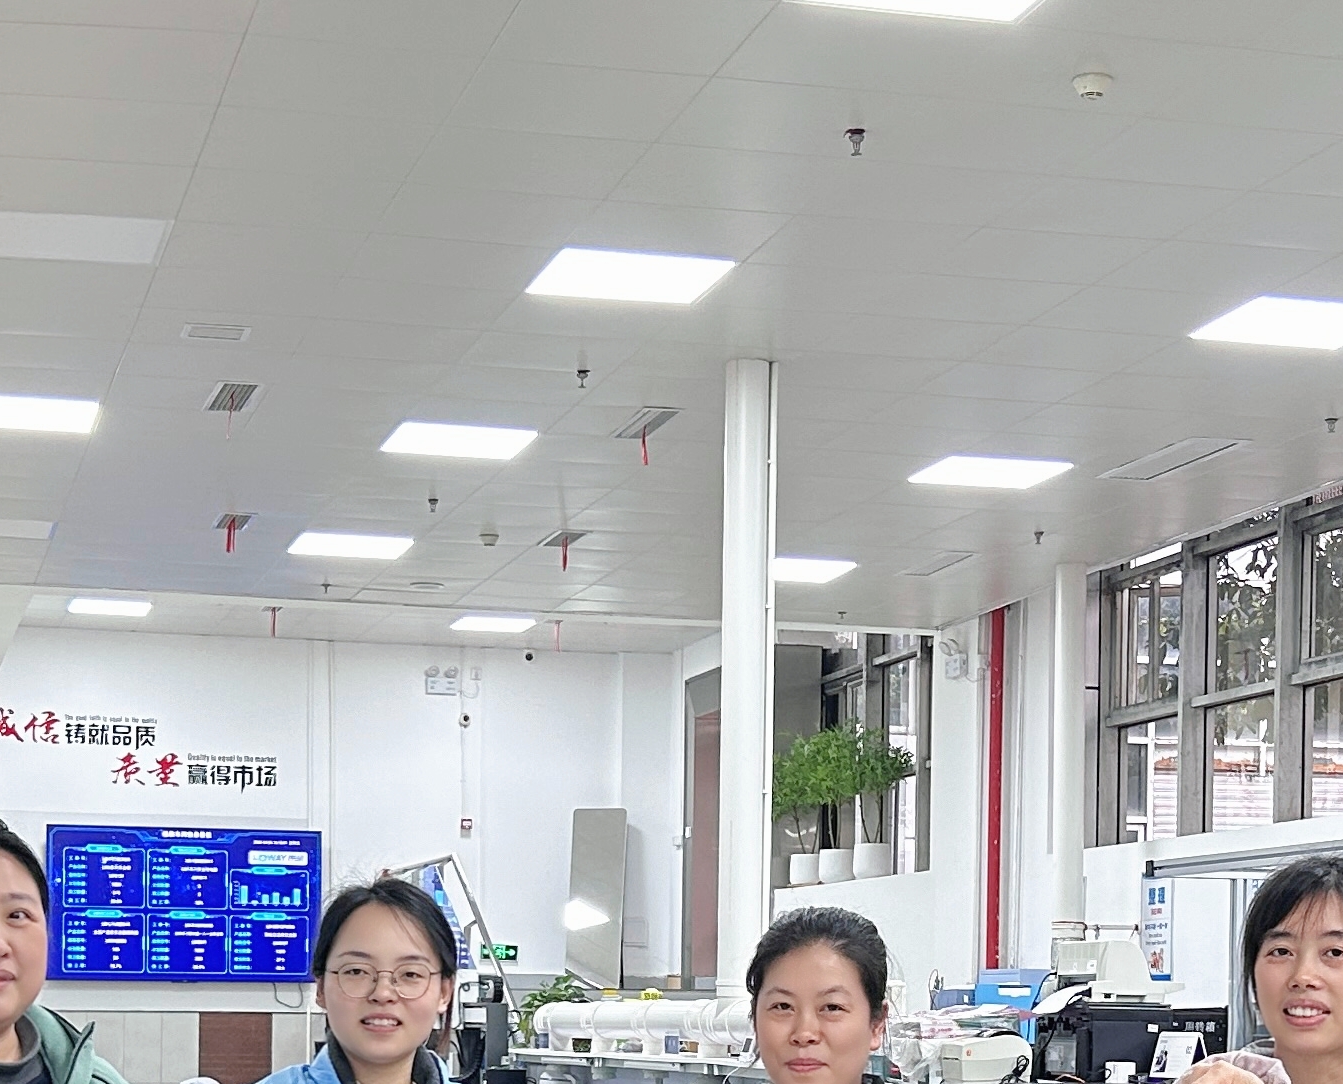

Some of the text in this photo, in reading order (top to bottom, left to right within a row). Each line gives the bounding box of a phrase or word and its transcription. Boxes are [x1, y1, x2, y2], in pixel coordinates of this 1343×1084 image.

[65, 723, 157, 750] 铸就品质
[186, 763, 278, 794] 赢得市场
